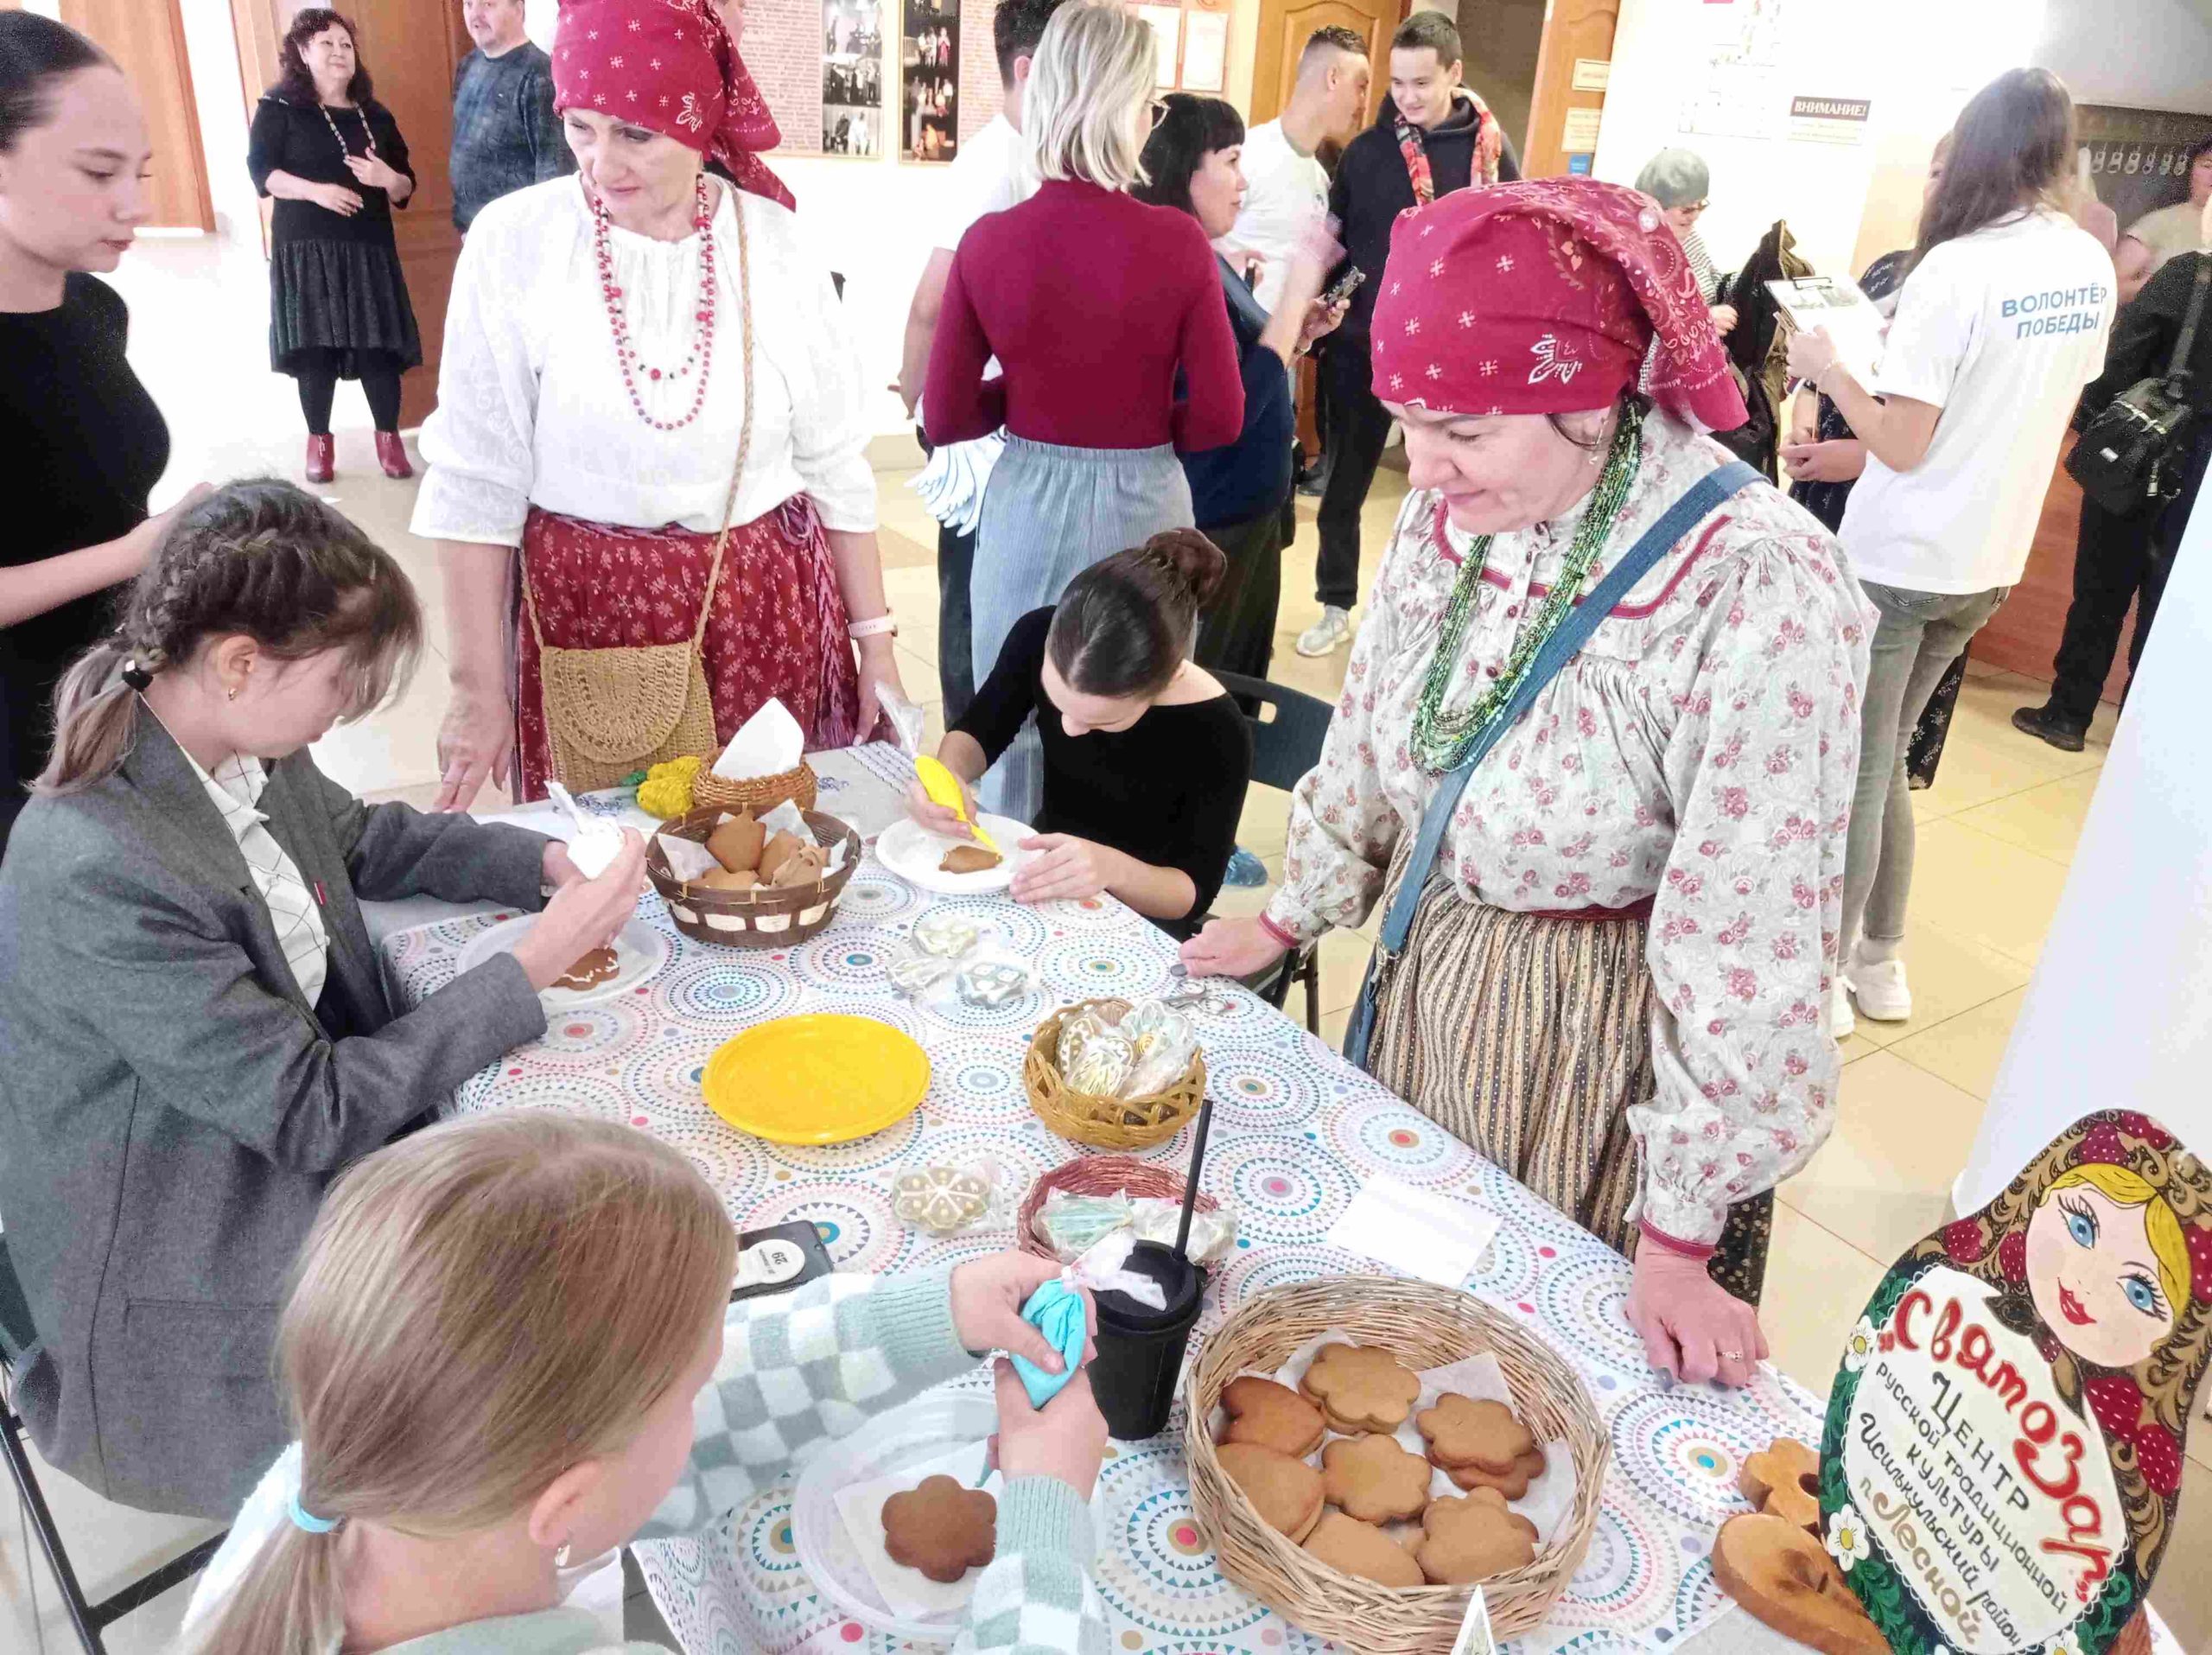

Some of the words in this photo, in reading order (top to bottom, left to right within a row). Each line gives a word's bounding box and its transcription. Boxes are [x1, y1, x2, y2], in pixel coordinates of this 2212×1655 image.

[1795, 100, 1867, 117] ВНИМАНИЕ!
[2002, 283, 2107, 318] ВОЛОНТЁР
[2016, 311, 2100, 340] ПОБЕДЫ
[1859, 1411, 1980, 1591] Исилькульский
[1965, 1588, 2022, 1645] район
[1876, 1362, 1941, 1449] русской
[1943, 1450, 2068, 1614] традиционной
[1872, 1492, 1984, 1645] Лесной
